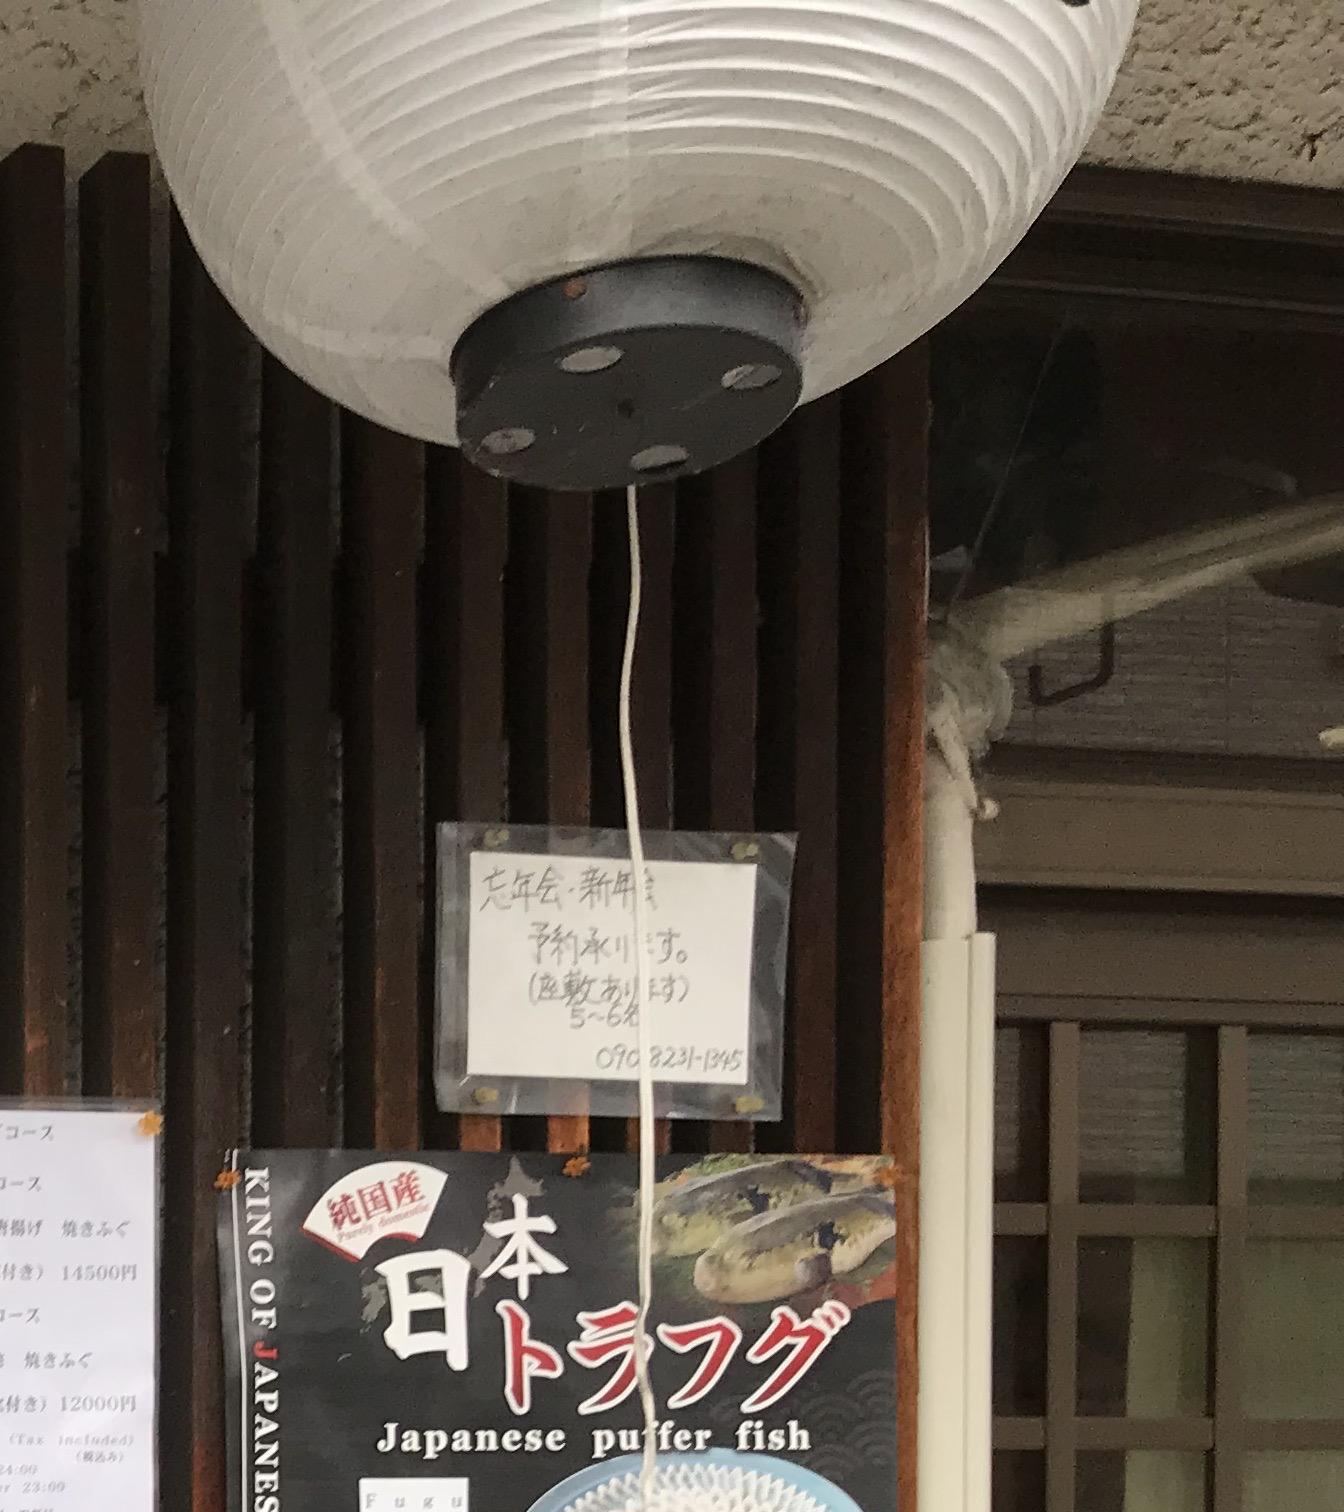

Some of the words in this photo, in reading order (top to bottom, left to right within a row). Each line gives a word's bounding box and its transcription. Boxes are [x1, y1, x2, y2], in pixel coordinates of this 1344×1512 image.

[245, 1167, 274, 1267] KING
[327, 1169, 425, 1231] 純国産
[62, 1264, 137, 1282] 14500円
[249, 1278, 277, 1329] OF
[495, 1299, 851, 1416] トラフグ
[60, 1395, 137, 1413] 12000円
[377, 1422, 567, 1460] Japanese
[735, 1419, 812, 1452] fish
